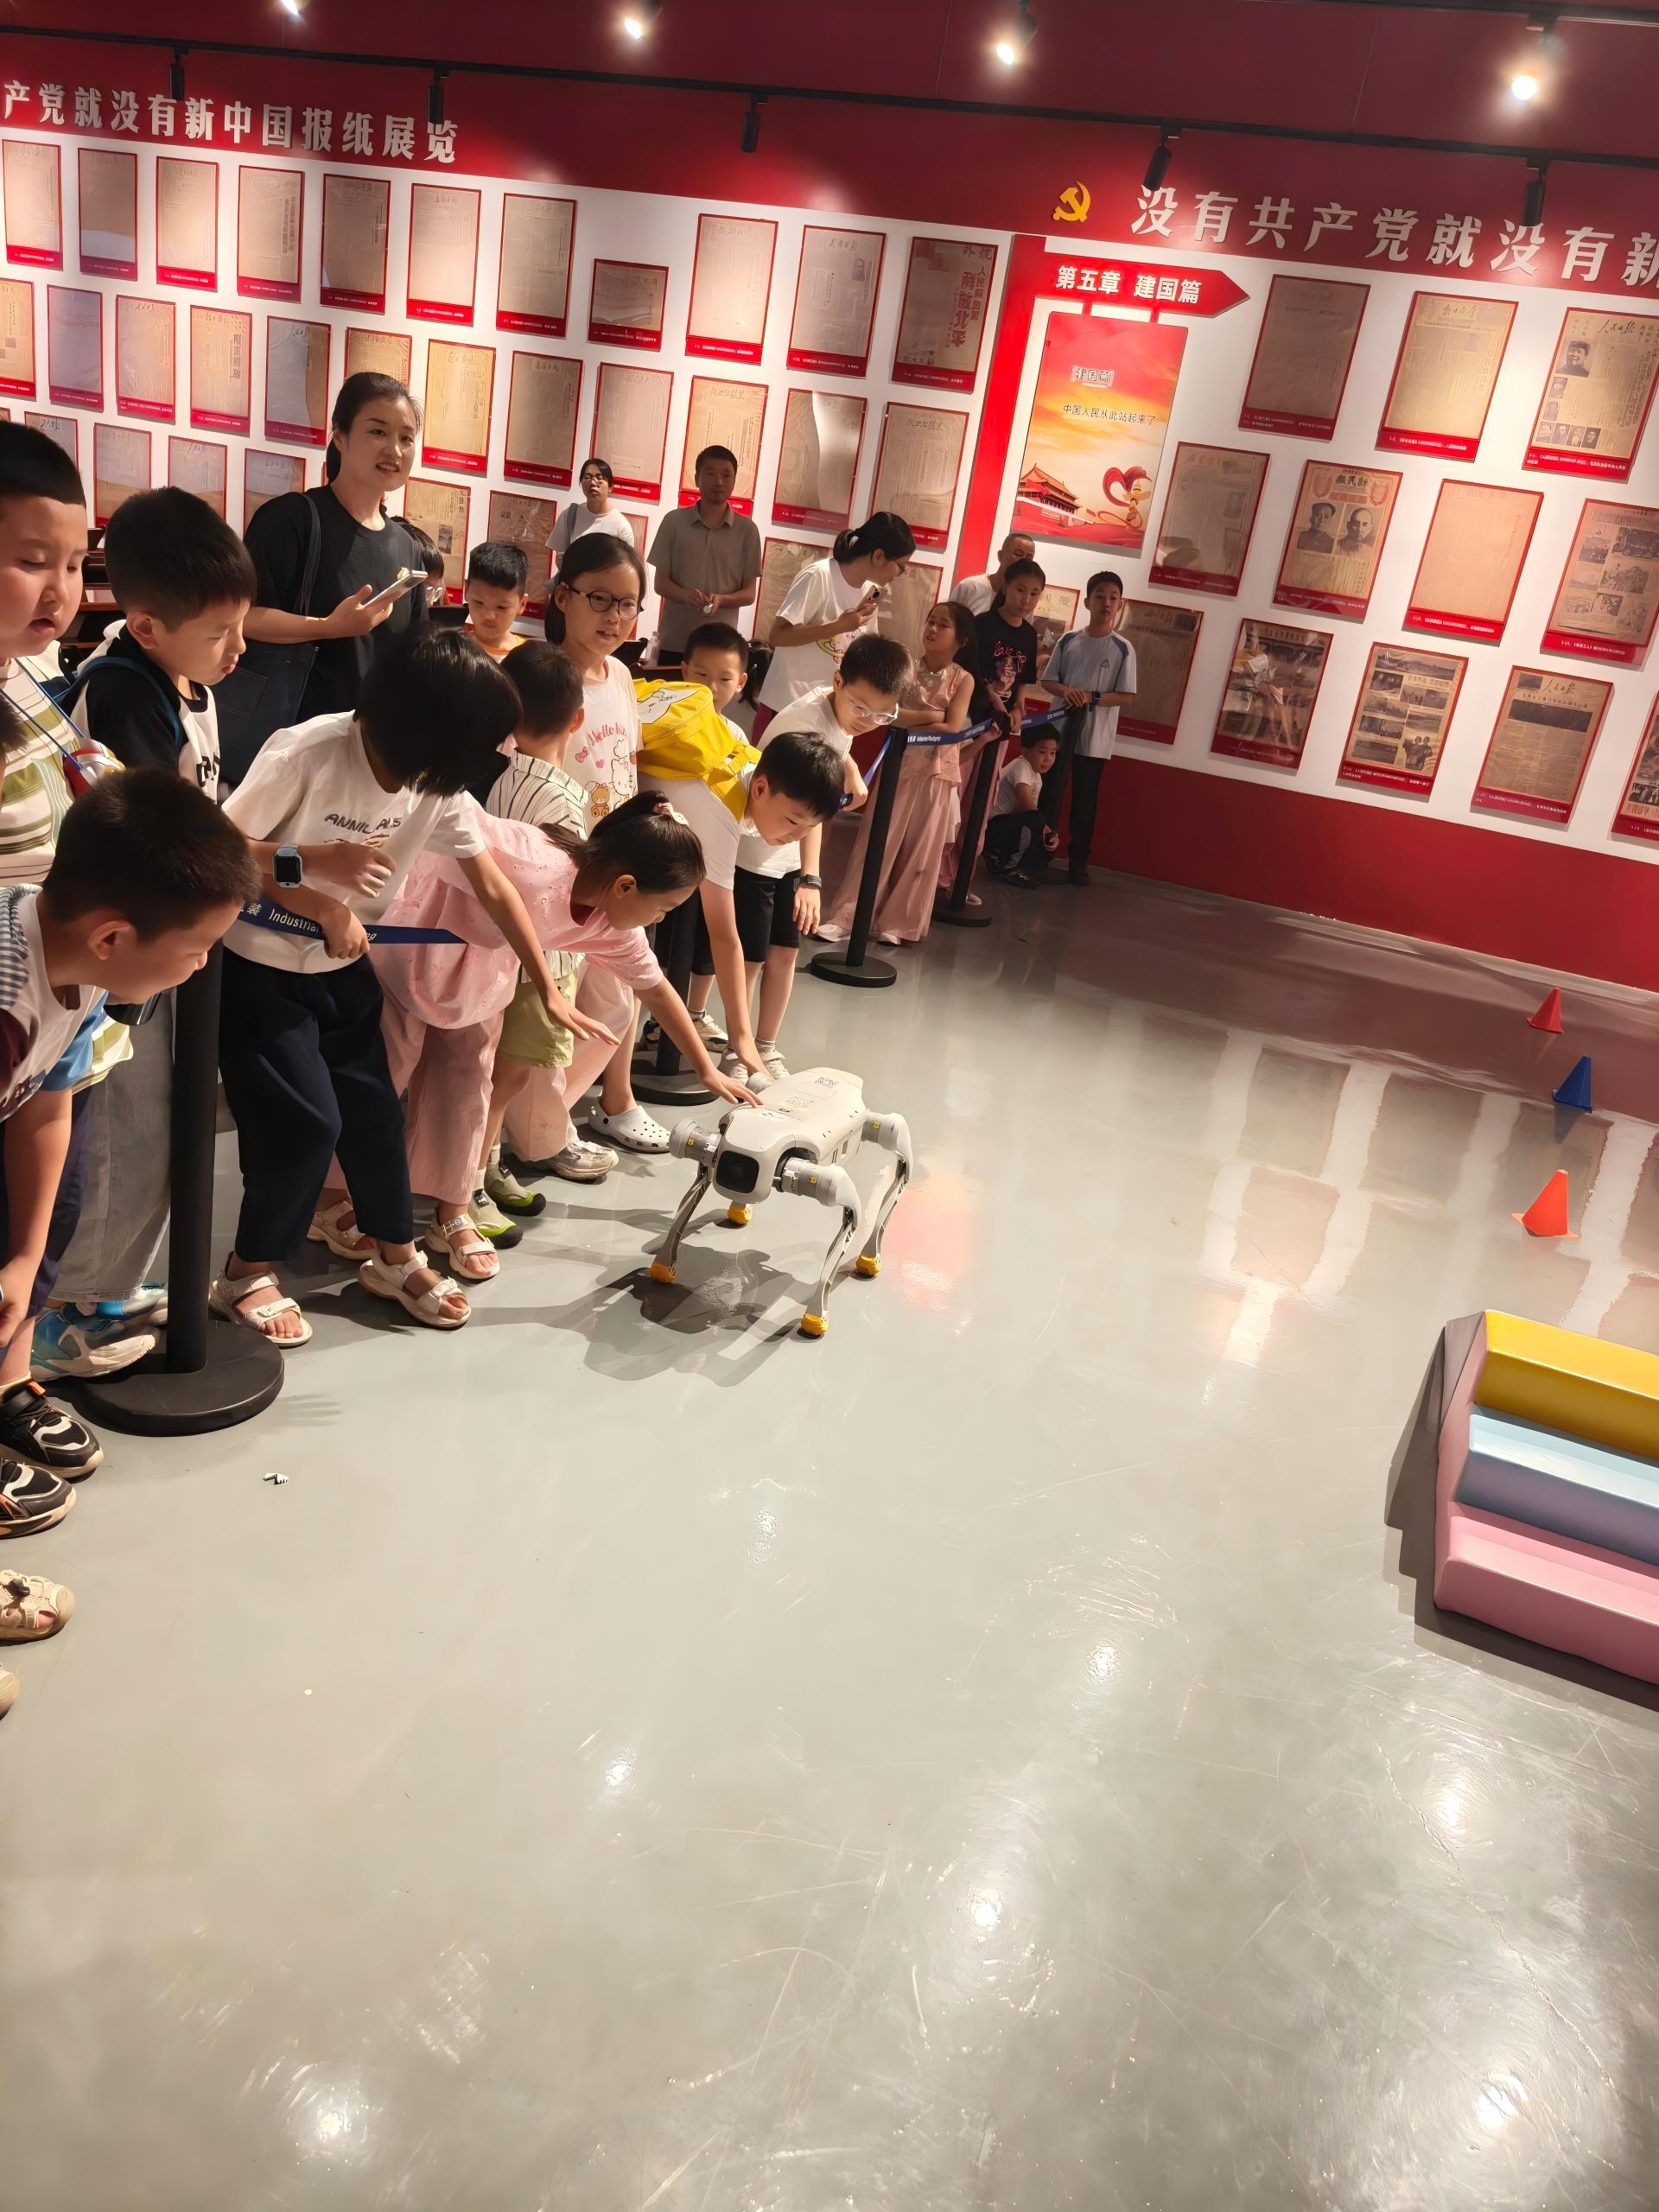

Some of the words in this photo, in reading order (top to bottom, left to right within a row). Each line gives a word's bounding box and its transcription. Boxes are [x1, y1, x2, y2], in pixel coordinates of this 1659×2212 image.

[3, 79, 459, 163] 产党就没有新中国报纸展览
[1130, 184, 1659, 289] 没有共产党就没有新
[1056, 264, 1121, 295] 第五章
[1134, 275, 1202, 304] 建国篇
[1063, 404, 1156, 425] 中国人民从此站起来了
